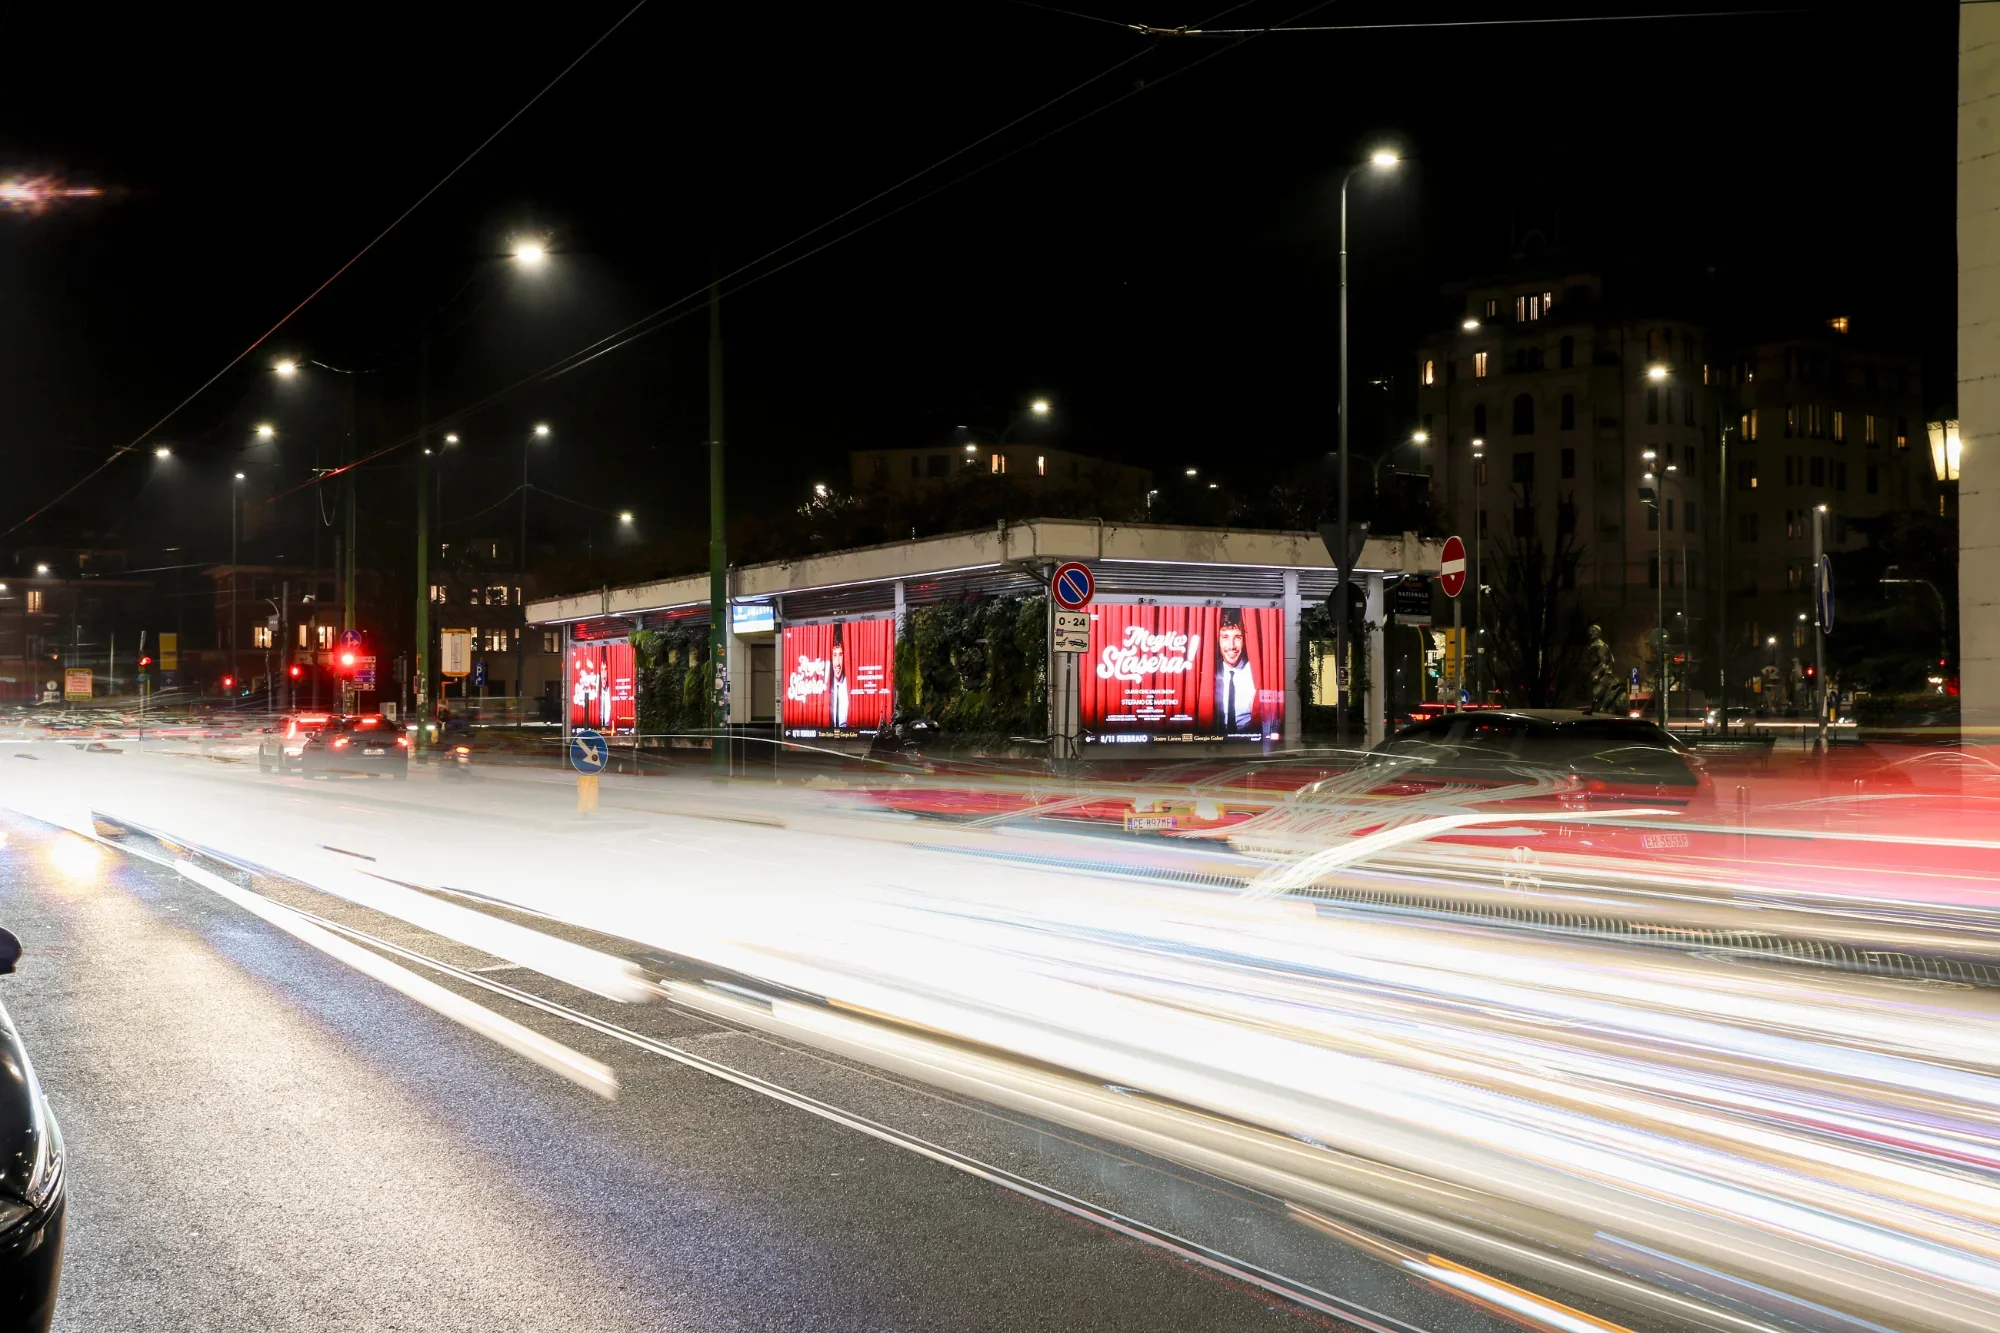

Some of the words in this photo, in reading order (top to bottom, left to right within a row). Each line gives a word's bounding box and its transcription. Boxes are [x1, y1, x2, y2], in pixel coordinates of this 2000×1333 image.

[1397, 591, 1429, 599] NAZIONALE
[1058, 617, 1066, 626] 0
[1073, 618, 1086, 627] 24
[1124, 626, 1188, 652] Meglio
[1096, 634, 1201, 684] Stasera!
[476, 666, 483, 677] P
[1100, 735, 1115, 744] 8/11
[1116, 735, 1148, 743] FEBBRAIO
[1645, 835, 1659, 847] EH
